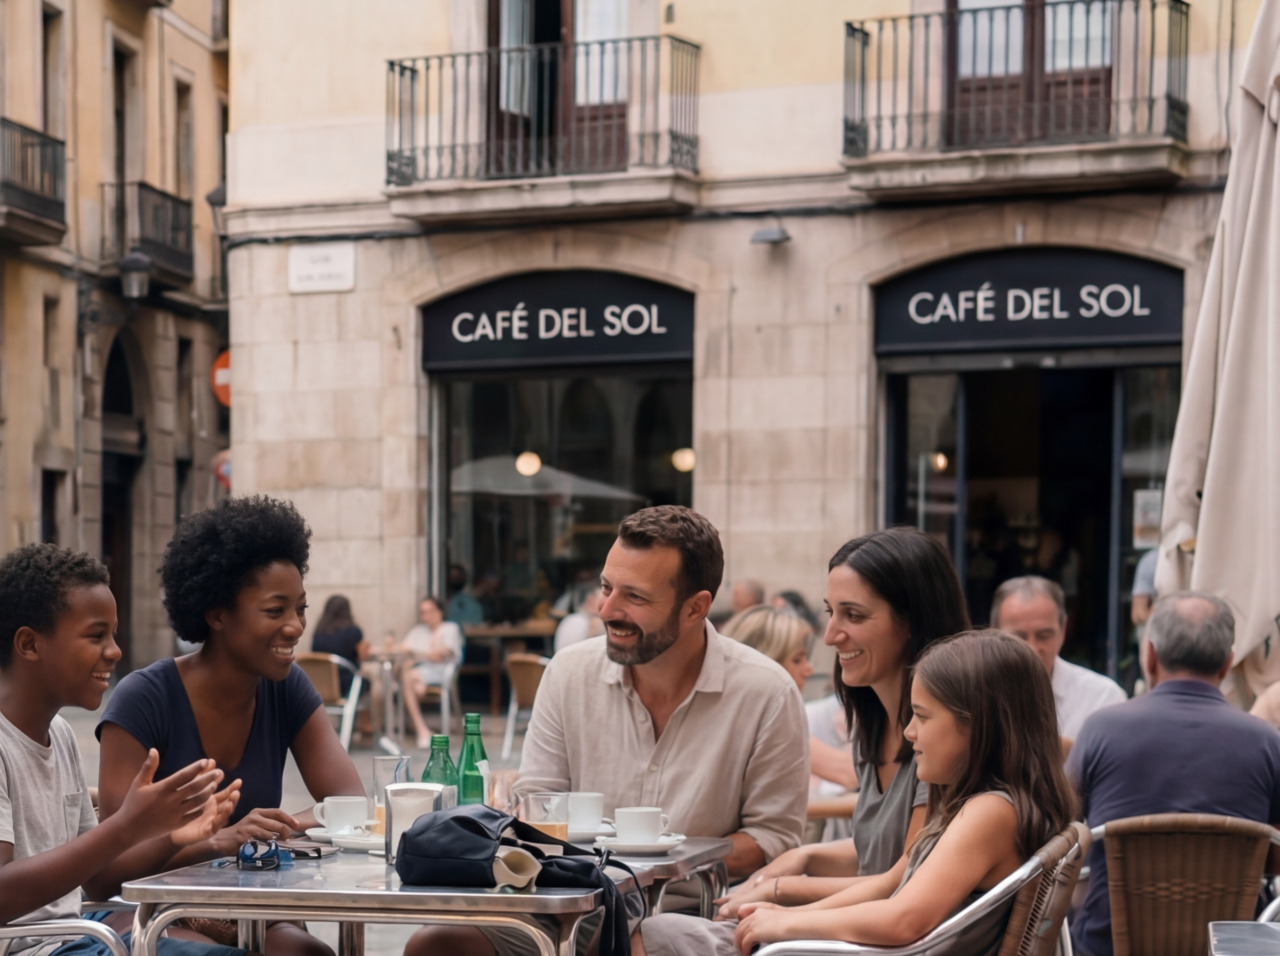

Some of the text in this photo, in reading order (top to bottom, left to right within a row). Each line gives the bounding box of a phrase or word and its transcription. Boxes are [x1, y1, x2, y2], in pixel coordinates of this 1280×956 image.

[451, 302, 667, 343] CAFÉ DEL SOL
[908, 281, 1151, 324] CAFÉ DEL SOL
